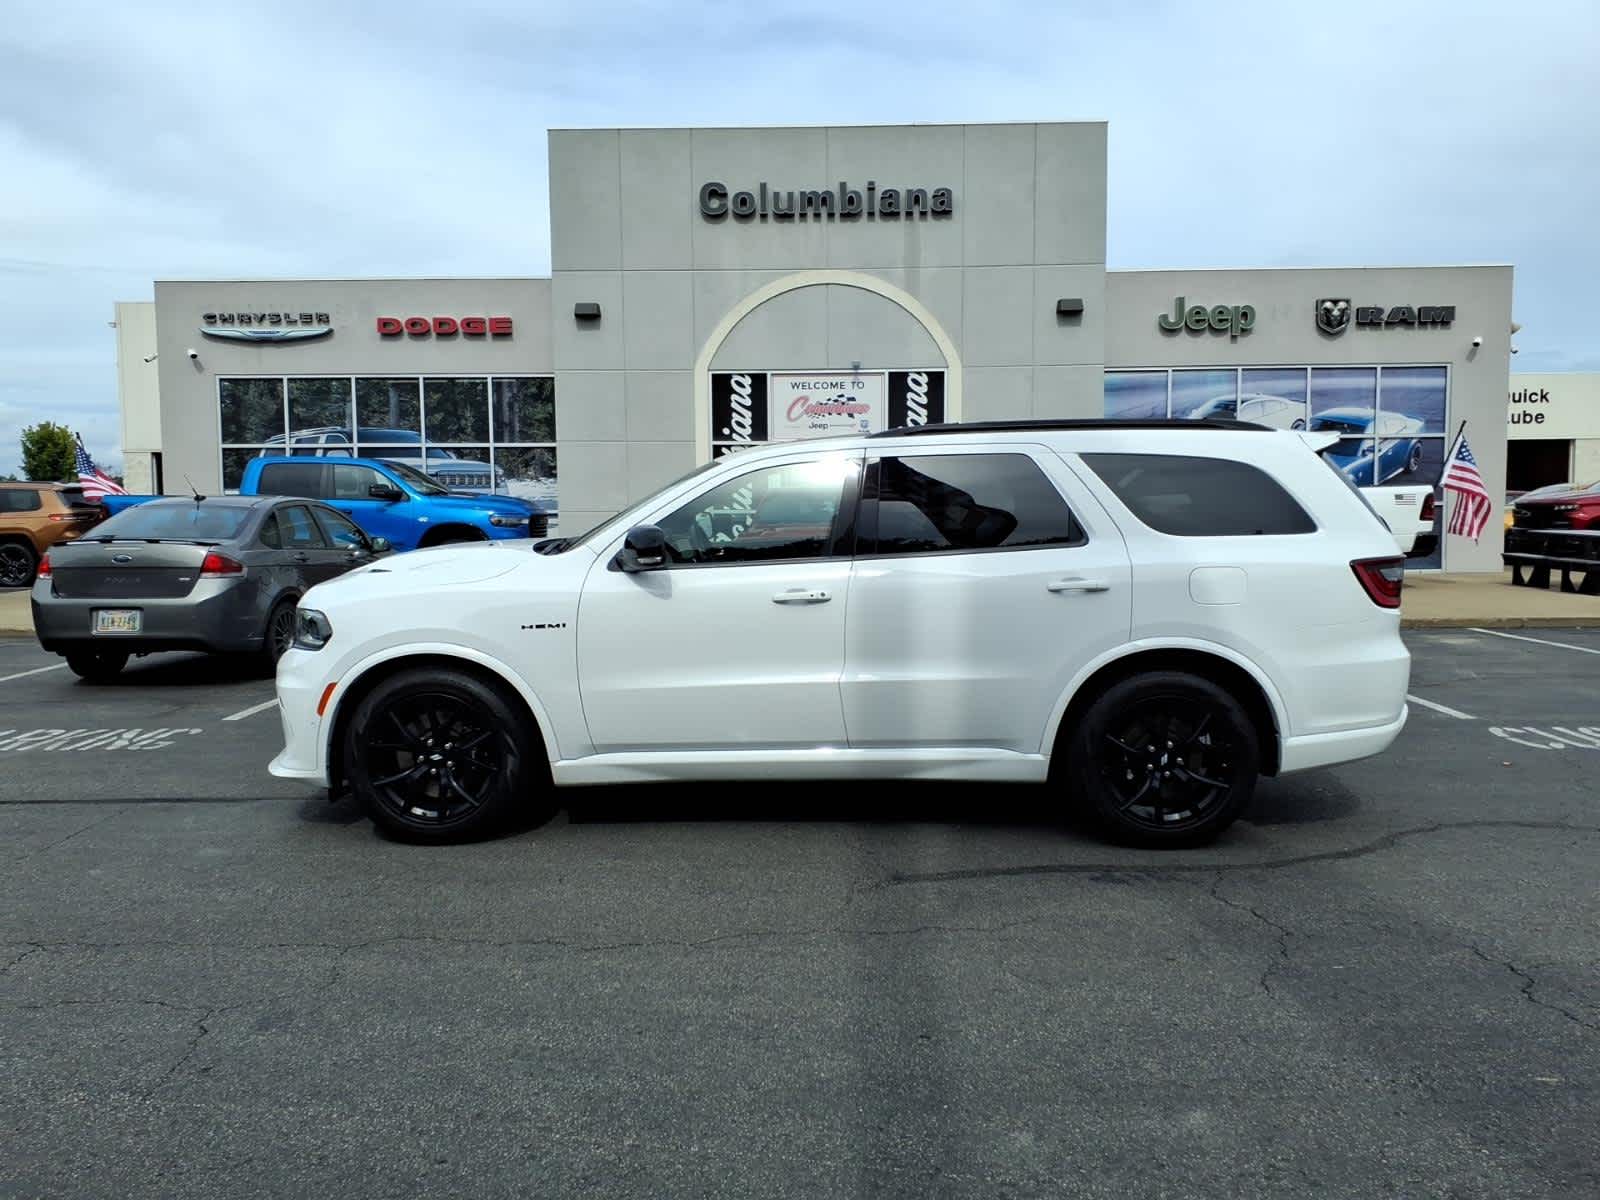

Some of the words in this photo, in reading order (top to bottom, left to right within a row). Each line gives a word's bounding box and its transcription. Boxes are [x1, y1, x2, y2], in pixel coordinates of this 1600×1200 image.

[699, 181, 953, 218] Columbiana
[202, 312, 330, 325] CHRYSLER
[1158, 296, 1256, 336] Jeep
[1355, 305, 1457, 326] RAM
[376, 316, 513, 336] DODGE
[790, 381, 846, 390] WELCOME
[851, 380, 865, 389] TO
[899, 372, 929, 428] ana
[1508, 388, 1550, 404] uick
[808, 421, 829, 430] Jeep
[1507, 410, 1545, 425] ube
[0, 728, 203, 751] RKING
